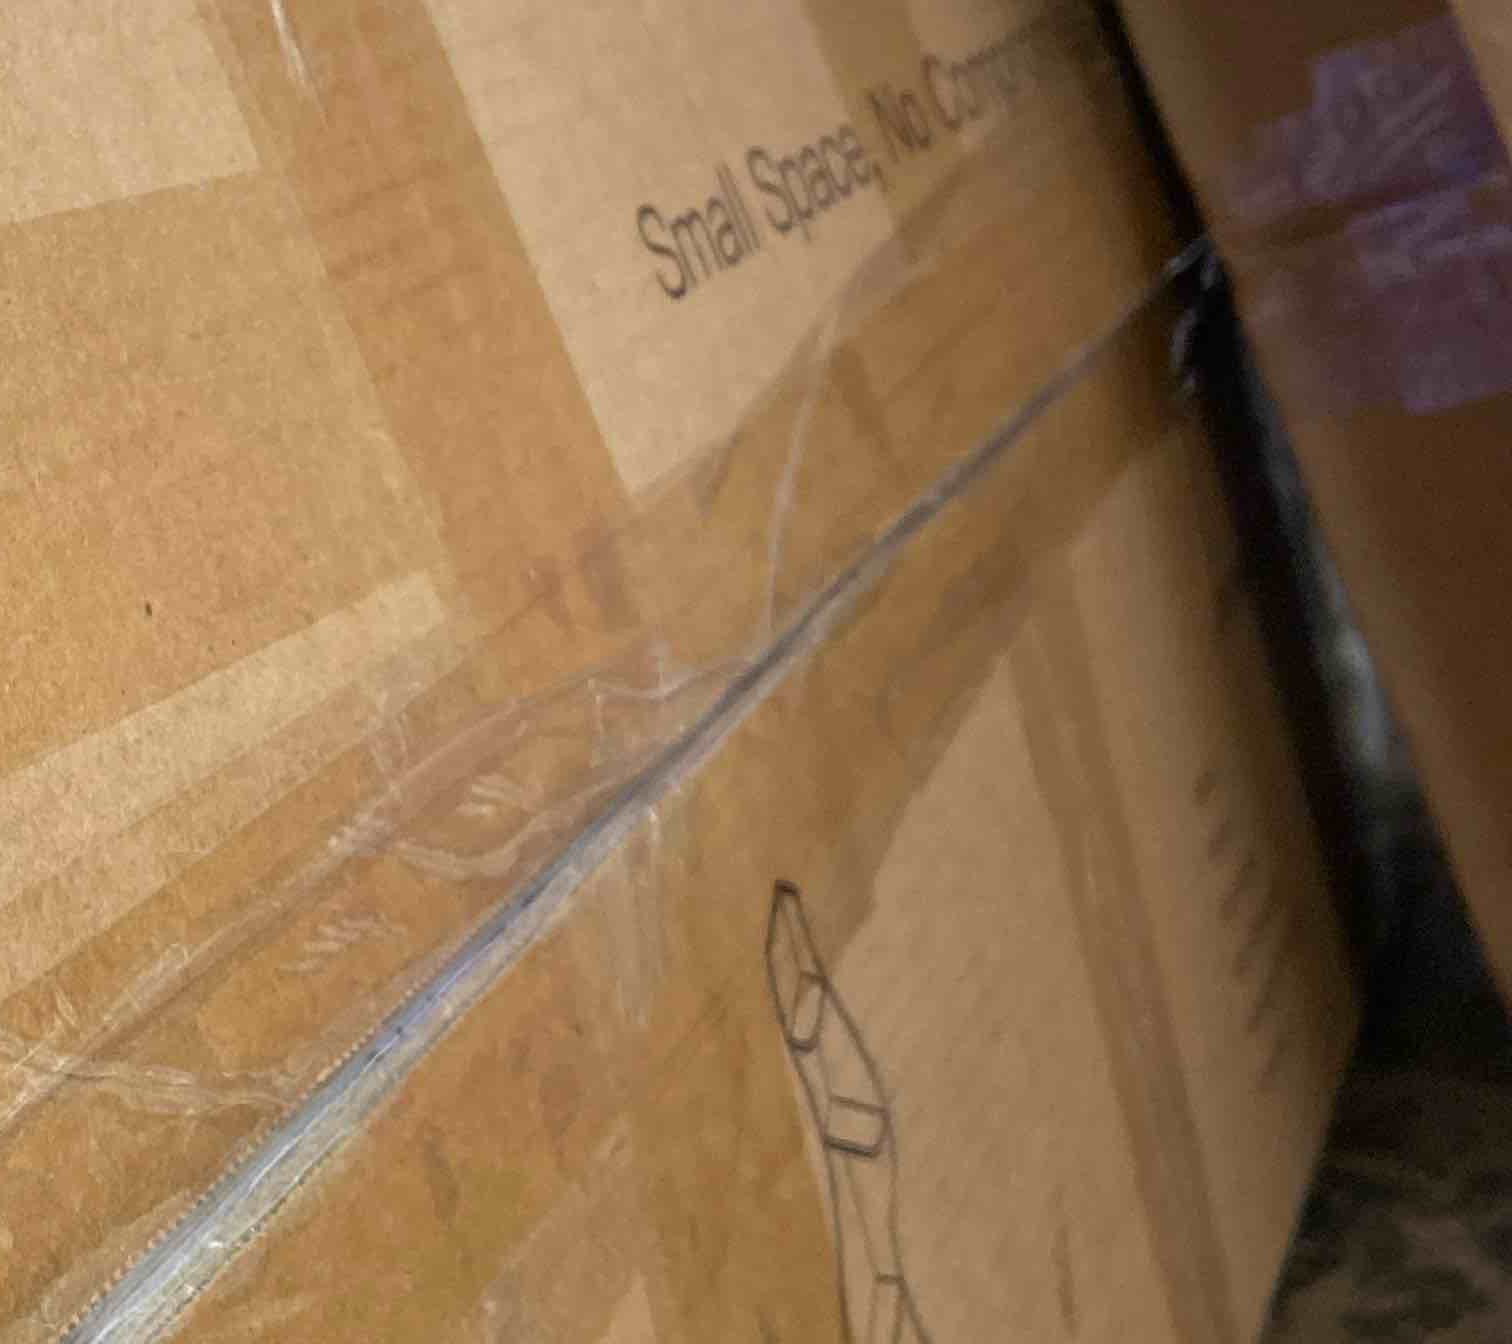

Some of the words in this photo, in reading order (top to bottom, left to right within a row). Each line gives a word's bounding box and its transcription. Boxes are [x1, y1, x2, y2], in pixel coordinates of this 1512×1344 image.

[636, 162, 762, 301] Small
[745, 121, 888, 245] Space,
[866, 79, 932, 163] No
